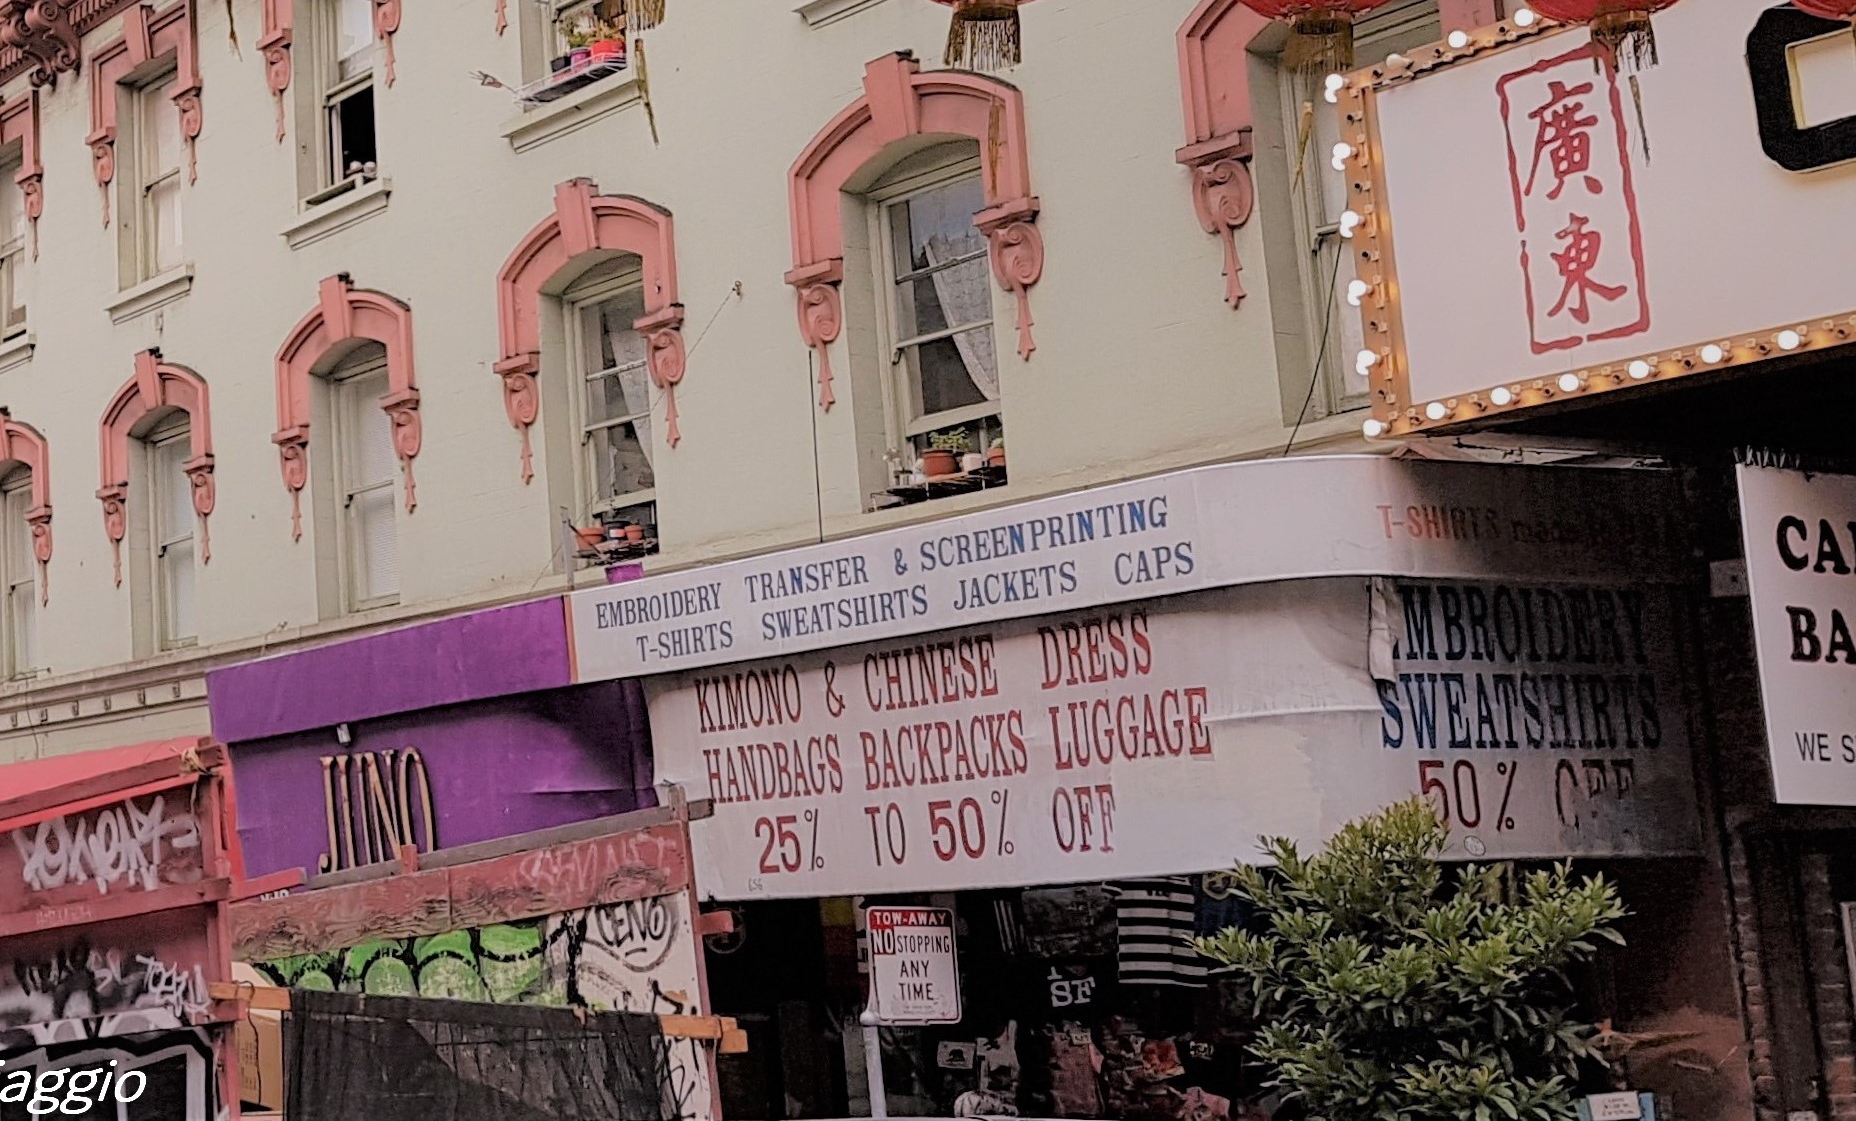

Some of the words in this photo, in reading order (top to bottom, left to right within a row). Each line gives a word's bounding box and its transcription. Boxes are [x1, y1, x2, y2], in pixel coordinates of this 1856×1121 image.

[1525, 80, 1627, 324] 廣東
[595, 582, 722, 630] EMBROIDERY
[743, 555, 870, 604] TRANSFER
[894, 547, 909, 576] &
[920, 495, 1168, 573] SCREENPRINTING
[636, 620, 734, 663] T-SHIRTS
[761, 584, 929, 643] SWEATSHIRTS
[953, 559, 1078, 611] JACKETS
[1114, 541, 1195, 586] CAPS
[1393, 584, 1648, 665] MBROIDERY
[695, 664, 802, 734] KIMONO
[824, 660, 846, 719] &
[863, 633, 999, 713] CHINESE
[1037, 611, 1152, 690] DRESS
[1375, 672, 1662, 751] SWEATSHIRTS
[703, 733, 843, 804] HANDBAGS
[859, 709, 1028, 791] BACKPACKS
[1048, 686, 1212, 770] LUGGAGE
[1795, 731, 1832, 762] WE
[754, 808, 825, 875] 25%
[864, 802, 906, 867] TO
[928, 789, 1015, 862] 50%
[1052, 783, 1117, 854] OFF
[872, 929, 895, 955] NO
[896, 934, 951, 954] STOPPING
[873, 911, 947, 926] TOW-AWAY
[898, 982, 935, 1002] TIME
[899, 959, 930, 978] ANY
[1049, 976, 1096, 1008] SF
